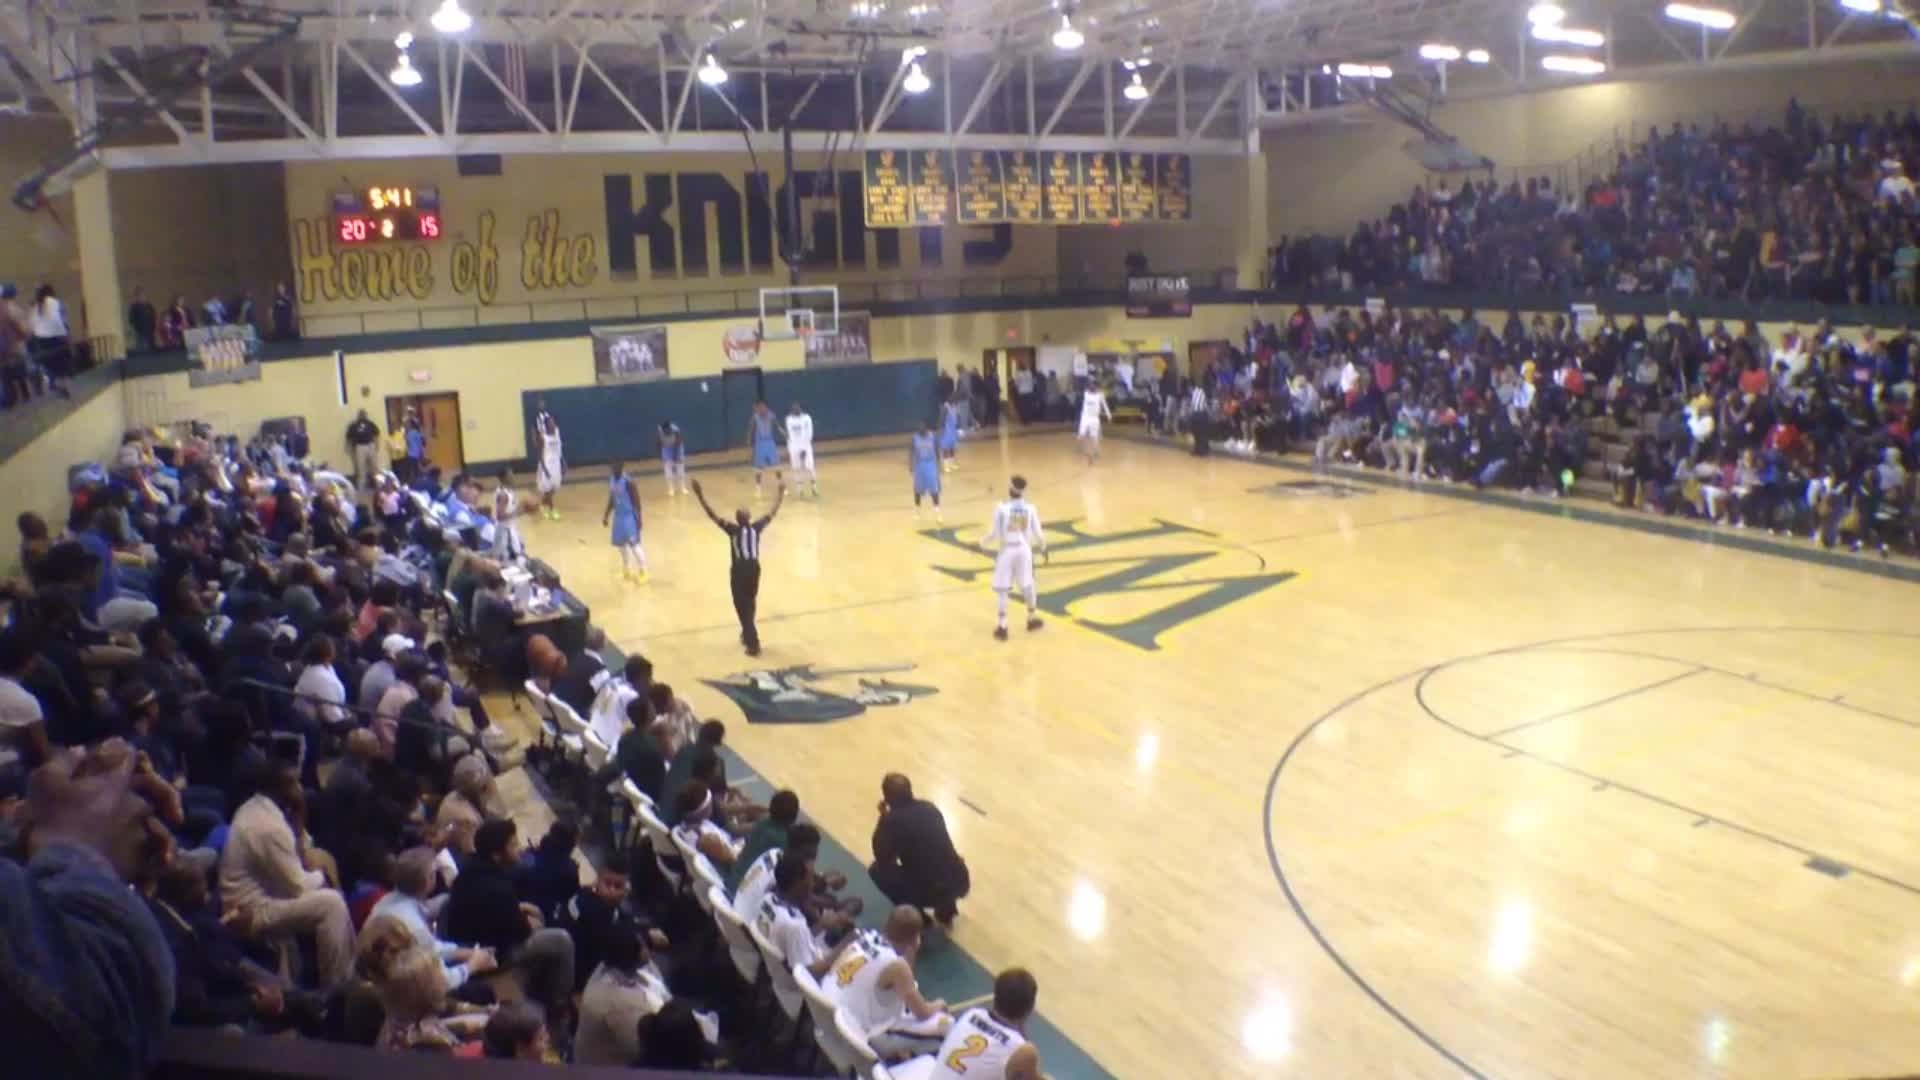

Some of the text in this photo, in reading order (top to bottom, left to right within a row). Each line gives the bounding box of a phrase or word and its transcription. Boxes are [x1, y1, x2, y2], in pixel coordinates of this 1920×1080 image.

[341, 218, 366, 240] 20
[420, 216, 438, 236] 15
[294, 216, 434, 303] Home
[452, 209, 498, 305] of
[520, 207, 597, 289] the
[946, 1034, 989, 1074] 2
